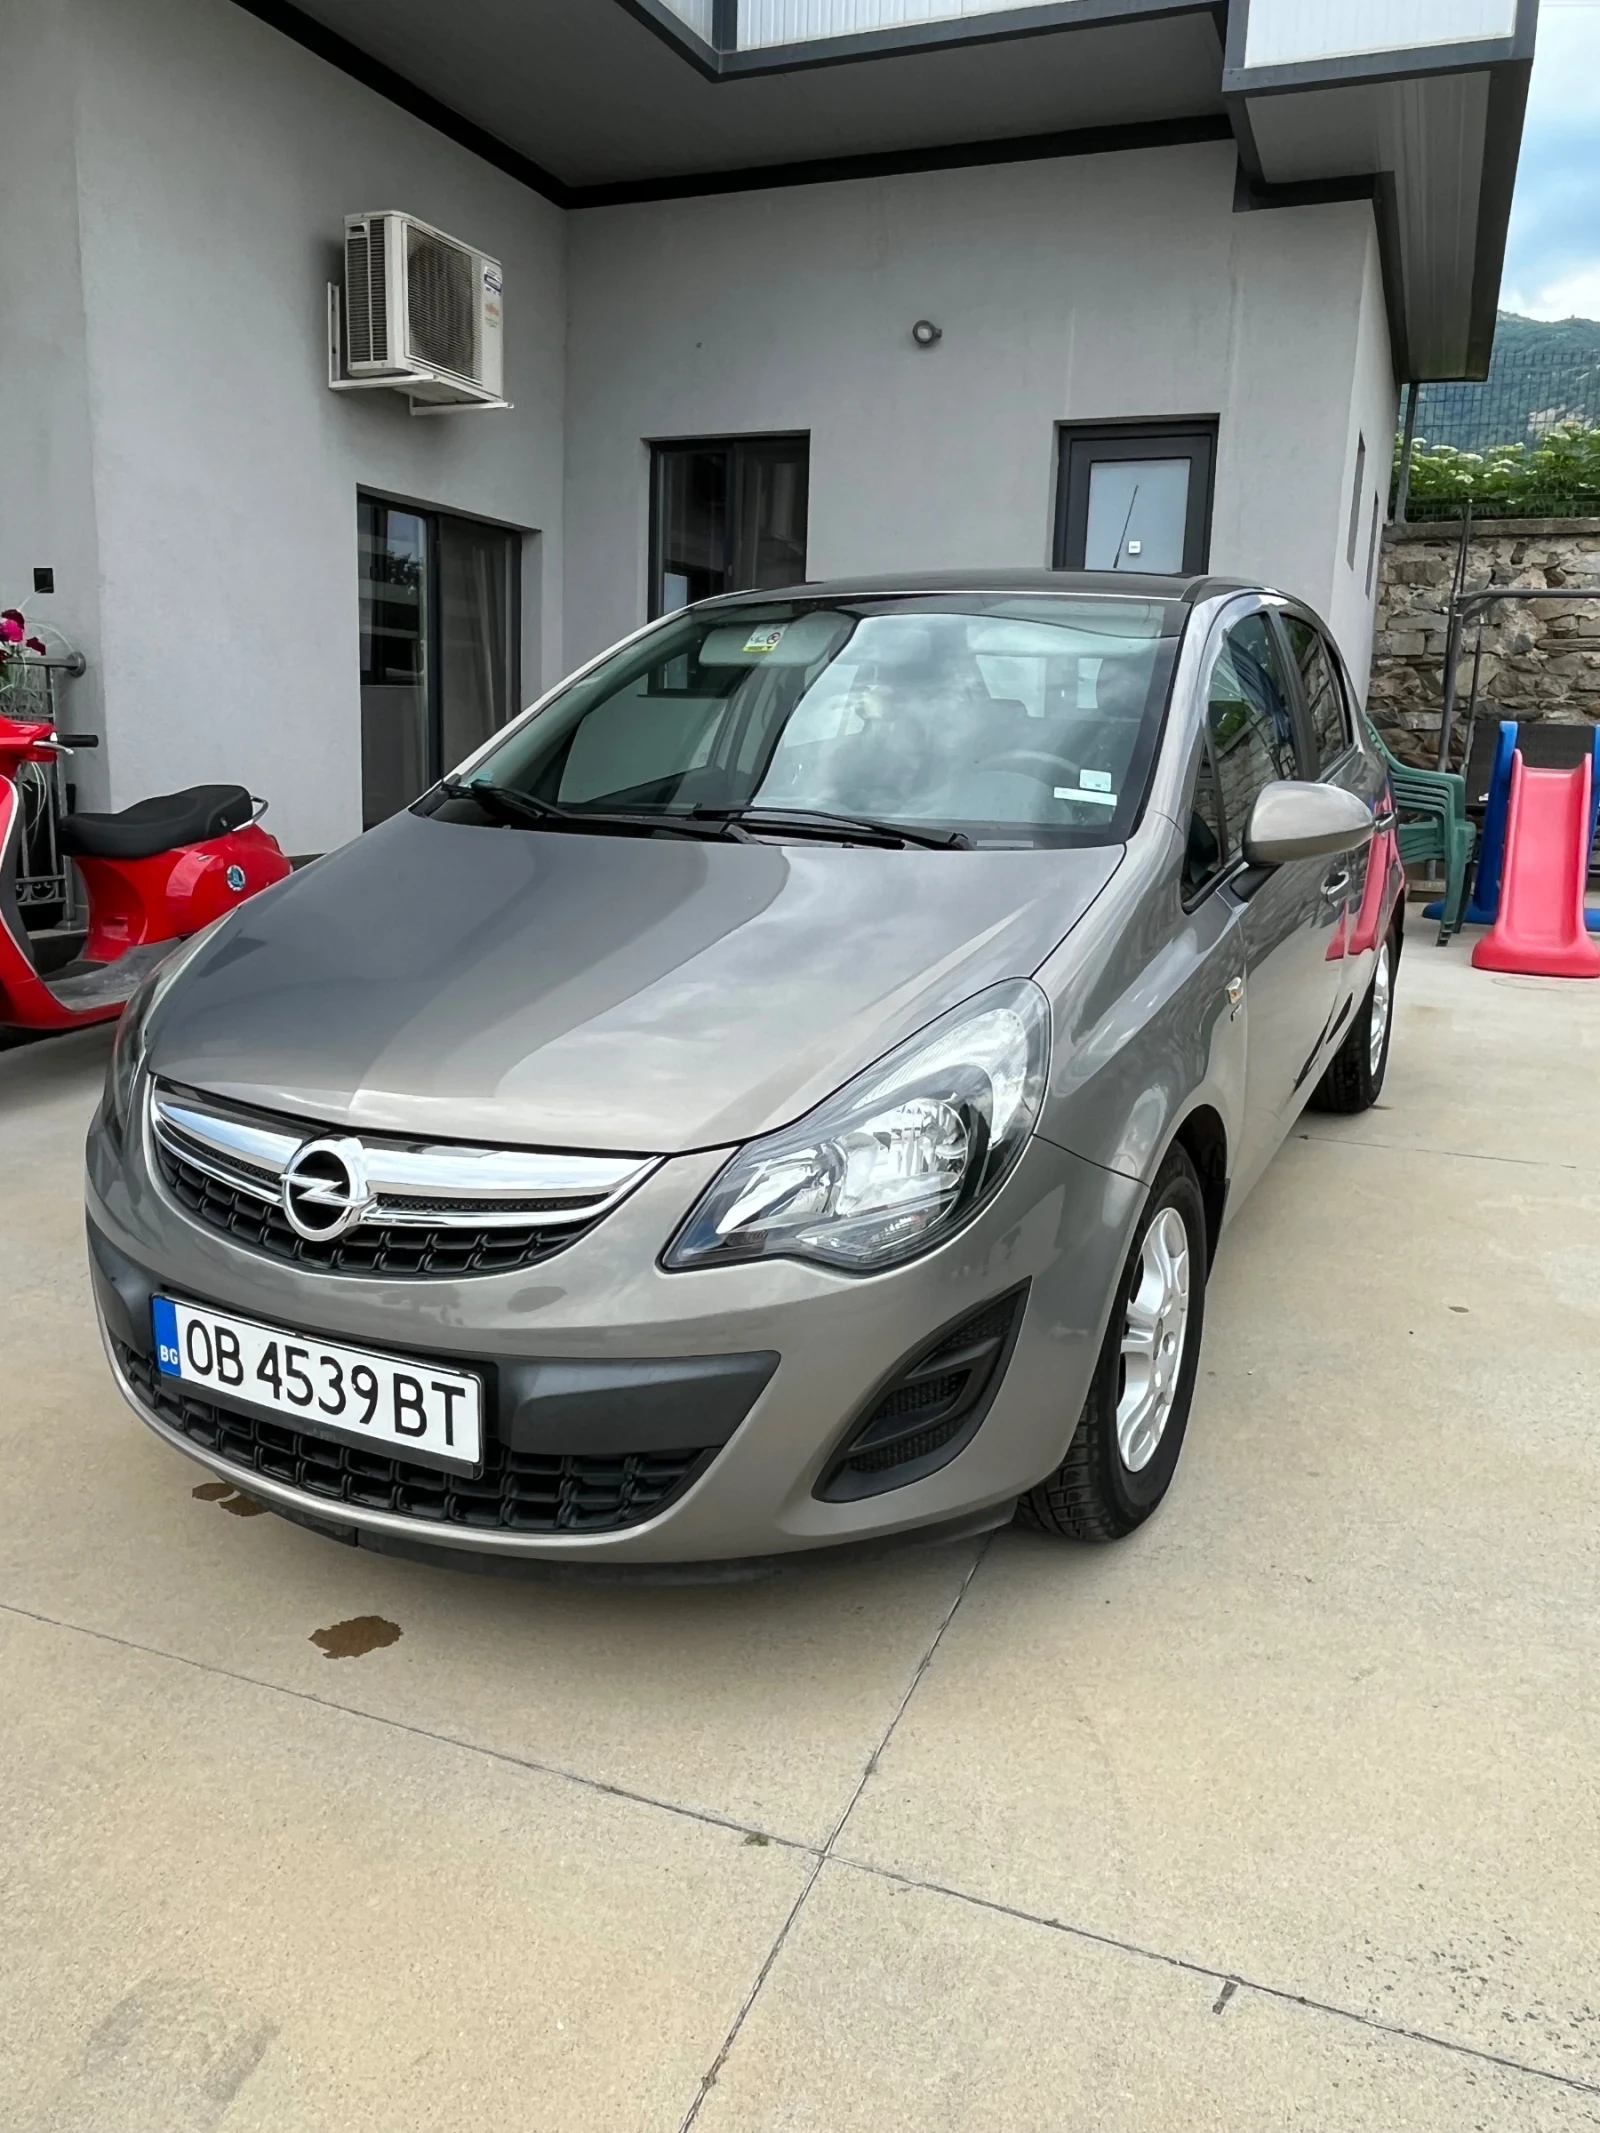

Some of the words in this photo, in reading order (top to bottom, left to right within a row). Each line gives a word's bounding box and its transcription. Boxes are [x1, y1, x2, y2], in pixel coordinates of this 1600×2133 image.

[160, 1344, 178, 1365] BG
[186, 1319, 244, 1386] OB
[257, 1341, 378, 1425] 4539
[393, 1372, 466, 1446] BT
